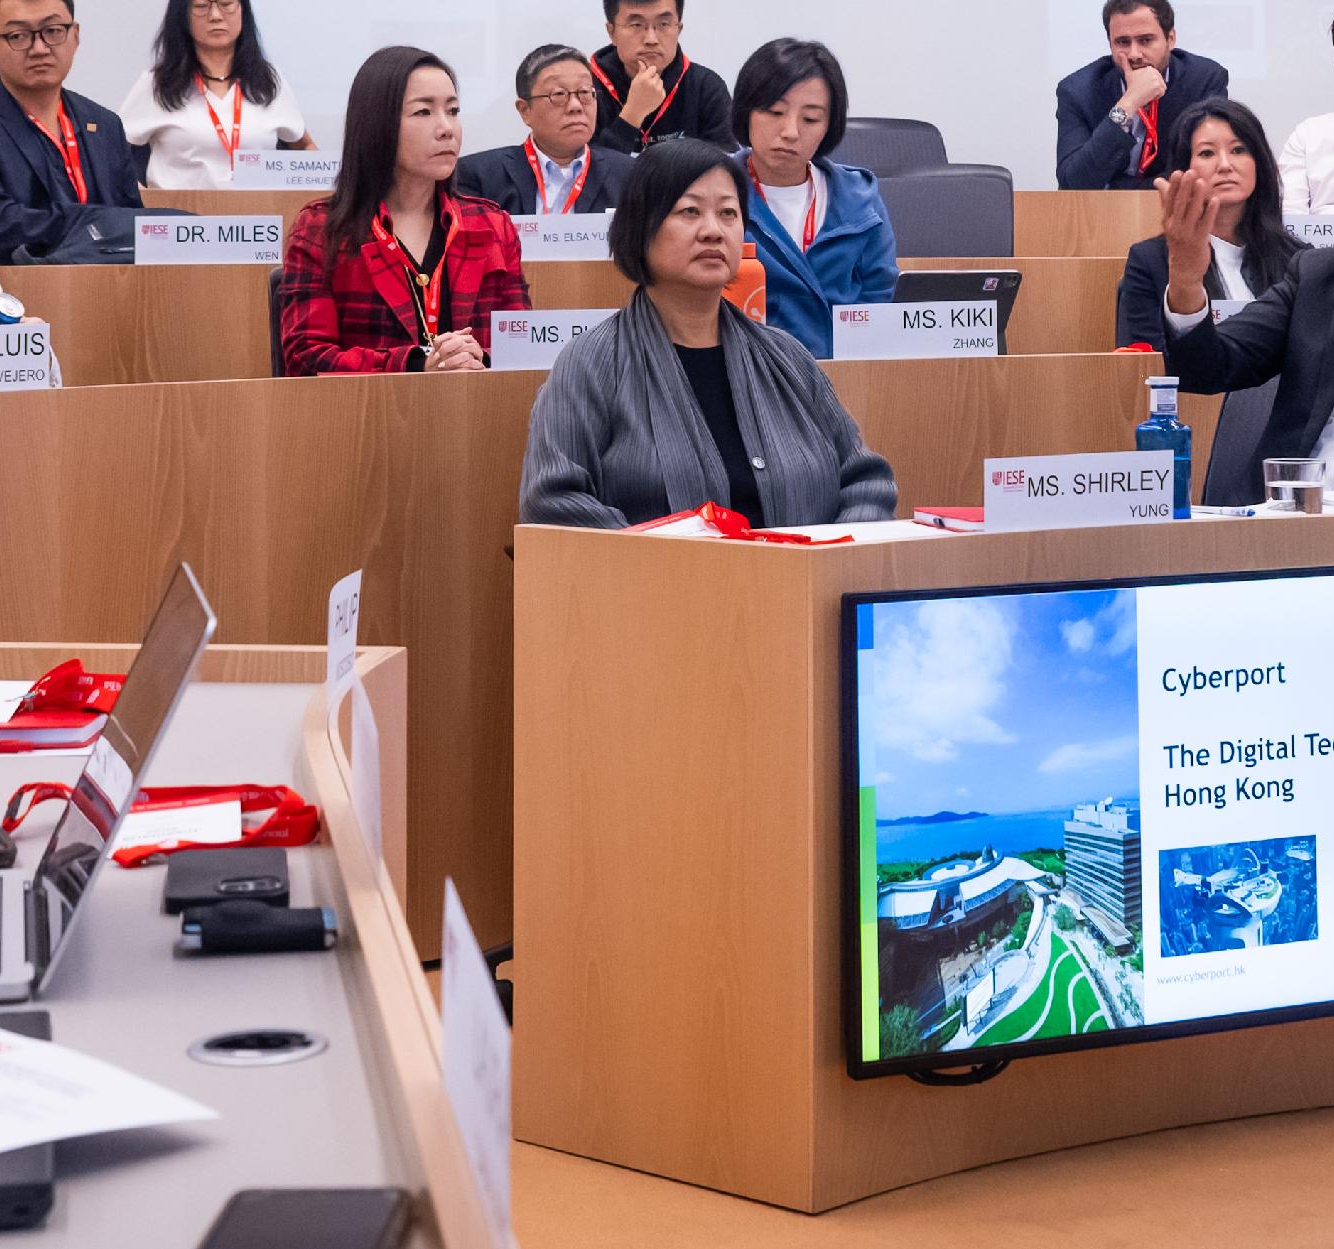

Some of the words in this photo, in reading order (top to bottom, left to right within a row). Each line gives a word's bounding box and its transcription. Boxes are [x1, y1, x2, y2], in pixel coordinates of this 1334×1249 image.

[150, 225, 168, 234] IESE
[176, 226, 210, 243] DR.
[218, 225, 279, 243] MILES
[522, 223, 538, 232] IESE
[564, 233, 589, 242] ELSA
[254, 252, 279, 260] WEN
[849, 311, 869, 323] IESE
[903, 309, 942, 329] MS.
[951, 307, 993, 328] KIKI
[509, 321, 528, 332] IESE
[531, 326, 564, 343] MS.
[953, 337, 994, 349] ZHANG
[1002, 470, 1025, 486] IESE
[1028, 475, 1065, 497] MS.
[1073, 470, 1169, 495] SHIRLEY
[1129, 504, 1169, 518] YUNG
[1162, 662, 1286, 696] Cyberport
[1163, 744, 1210, 769] The
[1219, 735, 1296, 767] Digital
[1165, 784, 1226, 809] Hong
[1236, 777, 1294, 802] Kong
[1156, 965, 1246, 986] www.cyberport.hk
